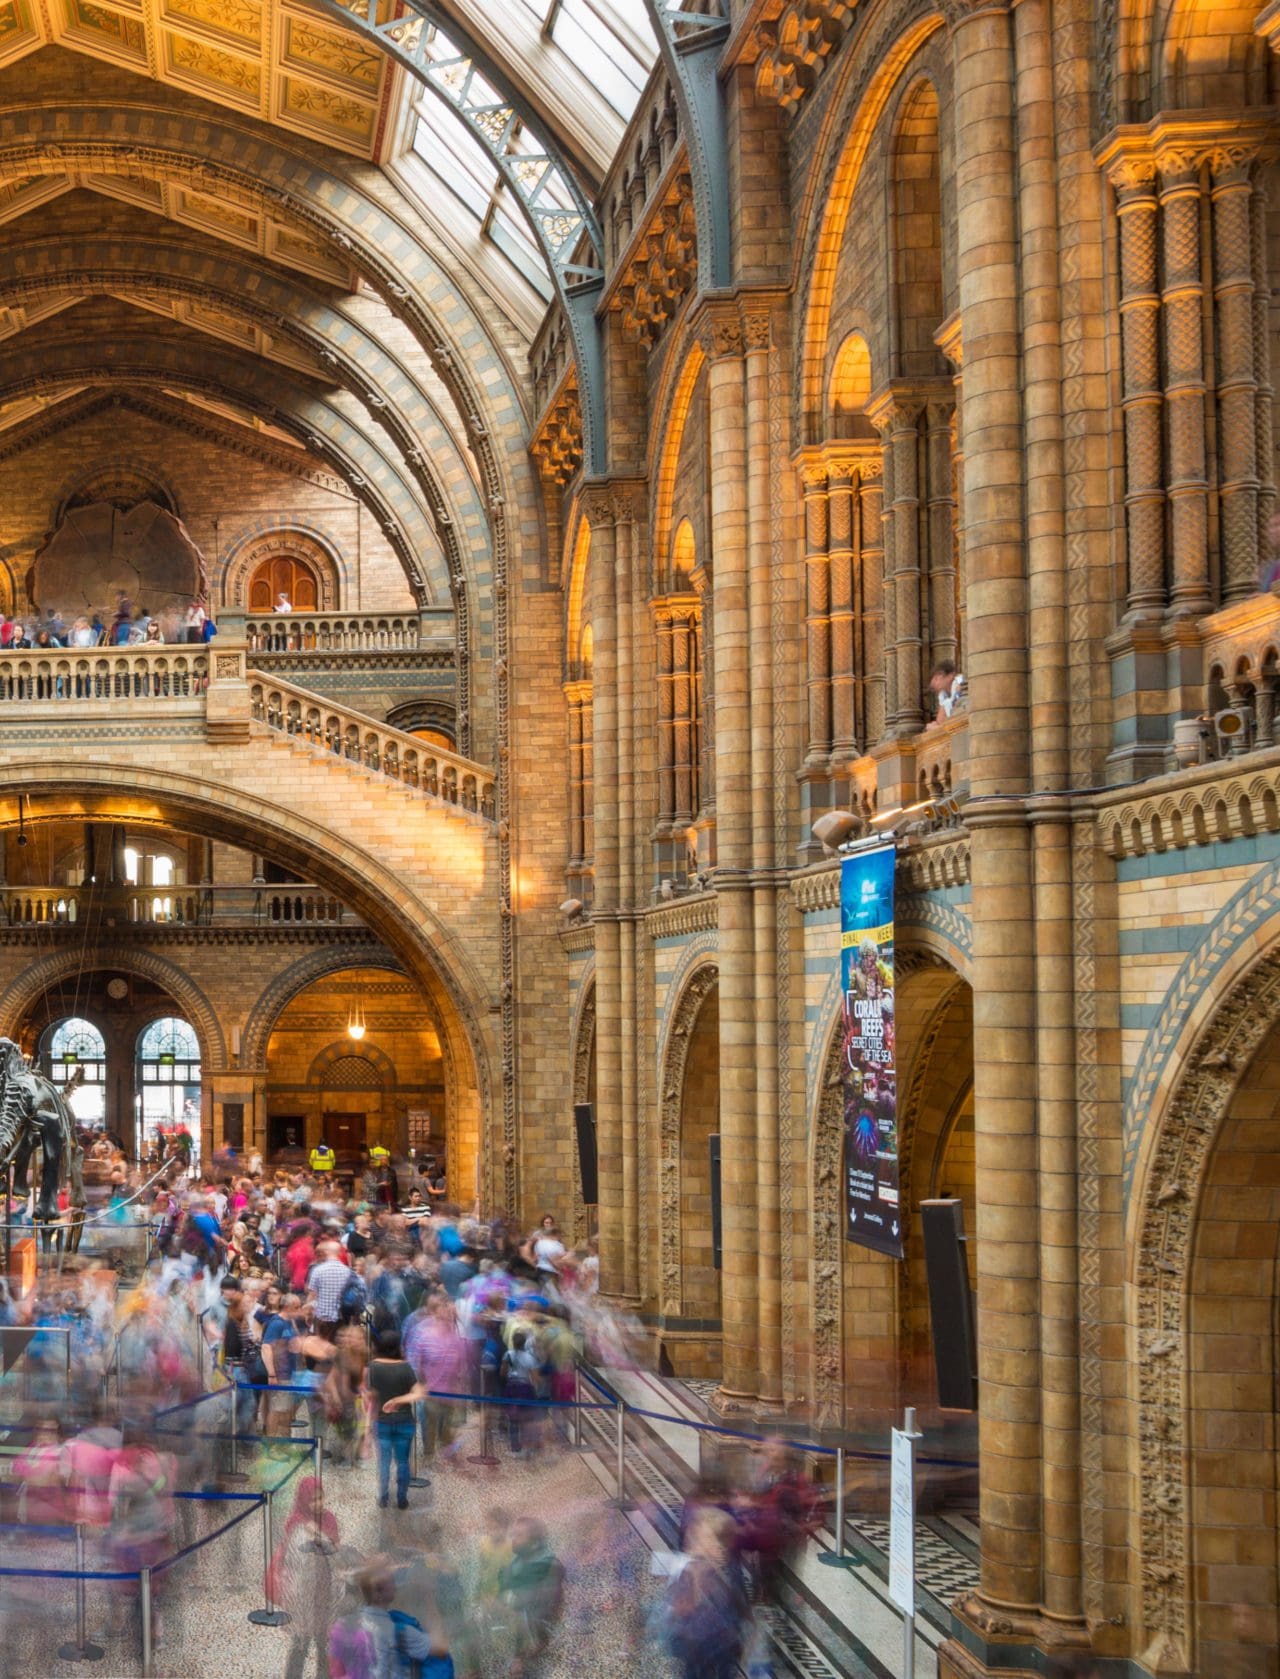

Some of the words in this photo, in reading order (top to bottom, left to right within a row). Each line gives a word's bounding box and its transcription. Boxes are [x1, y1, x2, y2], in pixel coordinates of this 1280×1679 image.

[842, 934, 859, 949] FINAL
[854, 999, 879, 1018] CORAL
[861, 1018, 884, 1037] REEFS
[851, 1036, 867, 1049] SECRET
[868, 1036, 883, 1050] CITIES
[865, 1049, 872, 1061] OF
[872, 1049, 880, 1062] THE
[881, 1050, 893, 1063] SEA
